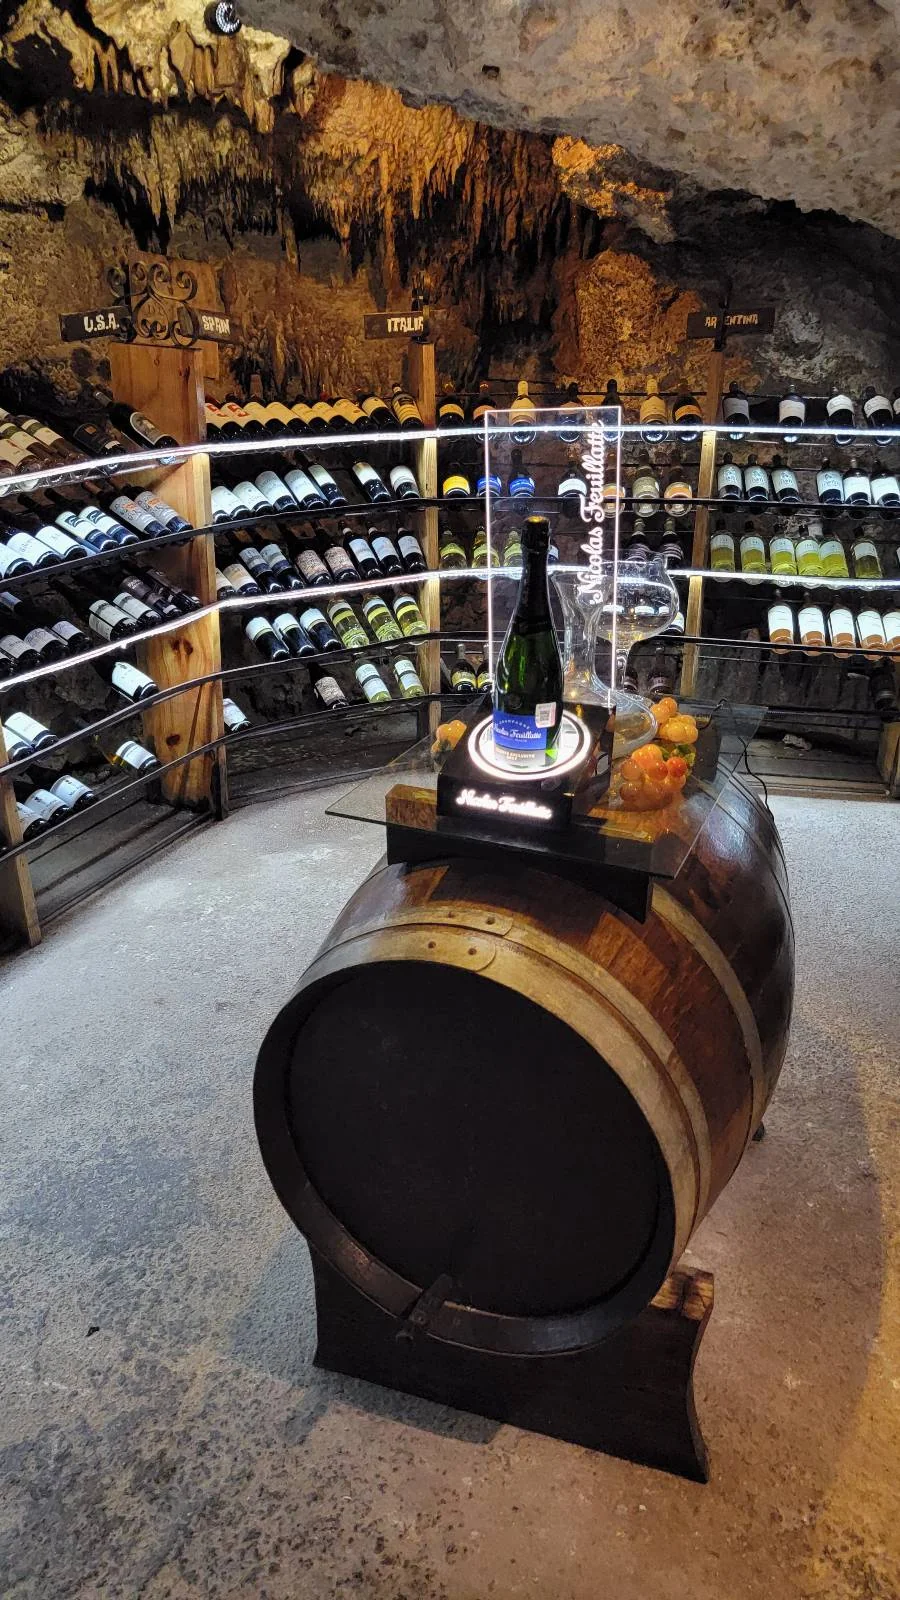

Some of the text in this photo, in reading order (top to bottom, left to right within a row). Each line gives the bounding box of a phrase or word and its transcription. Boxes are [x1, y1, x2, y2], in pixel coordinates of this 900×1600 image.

[83, 312, 120, 333] U.S.A.
[201, 315, 231, 334] SPAIN
[704, 313, 759, 329] ARENTINA
[577, 419, 605, 606] Nicolas Feuillatte
